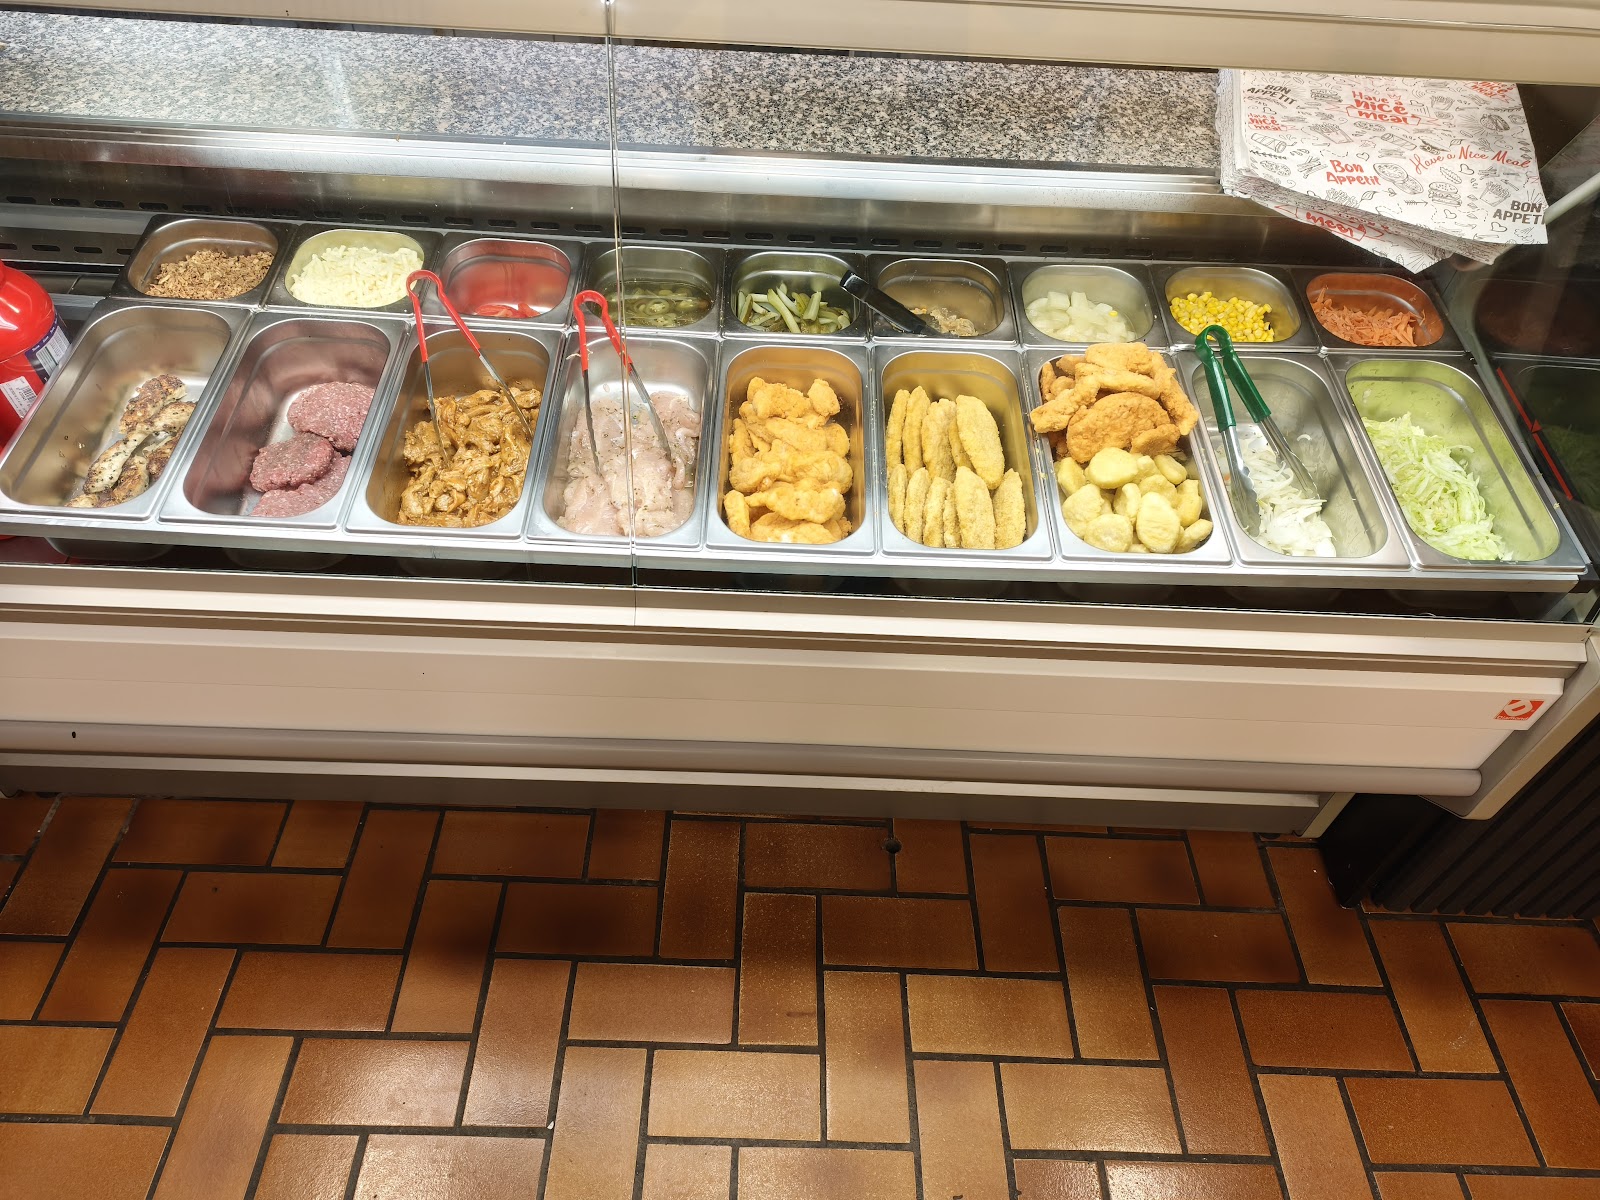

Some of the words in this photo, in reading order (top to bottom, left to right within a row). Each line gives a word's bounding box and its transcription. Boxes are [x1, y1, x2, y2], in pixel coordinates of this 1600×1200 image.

[1246, 87, 1298, 105] APPETIT
[1264, 84, 1292, 95] BON
[1352, 90, 1390, 104] Have
[1354, 98, 1409, 115] nice
[1248, 117, 1280, 126] nice
[1357, 110, 1409, 125] meal
[1329, 159, 1364, 173] Bon
[1409, 153, 1445, 175] Have
[1458, 144, 1489, 160] Nice
[1491, 150, 1533, 169] Meal
[1326, 172, 1381, 186] Appetit
[1510, 200, 1543, 213] BON
[1492, 208, 1546, 226] APPETI
[1305, 211, 1354, 238] meal
